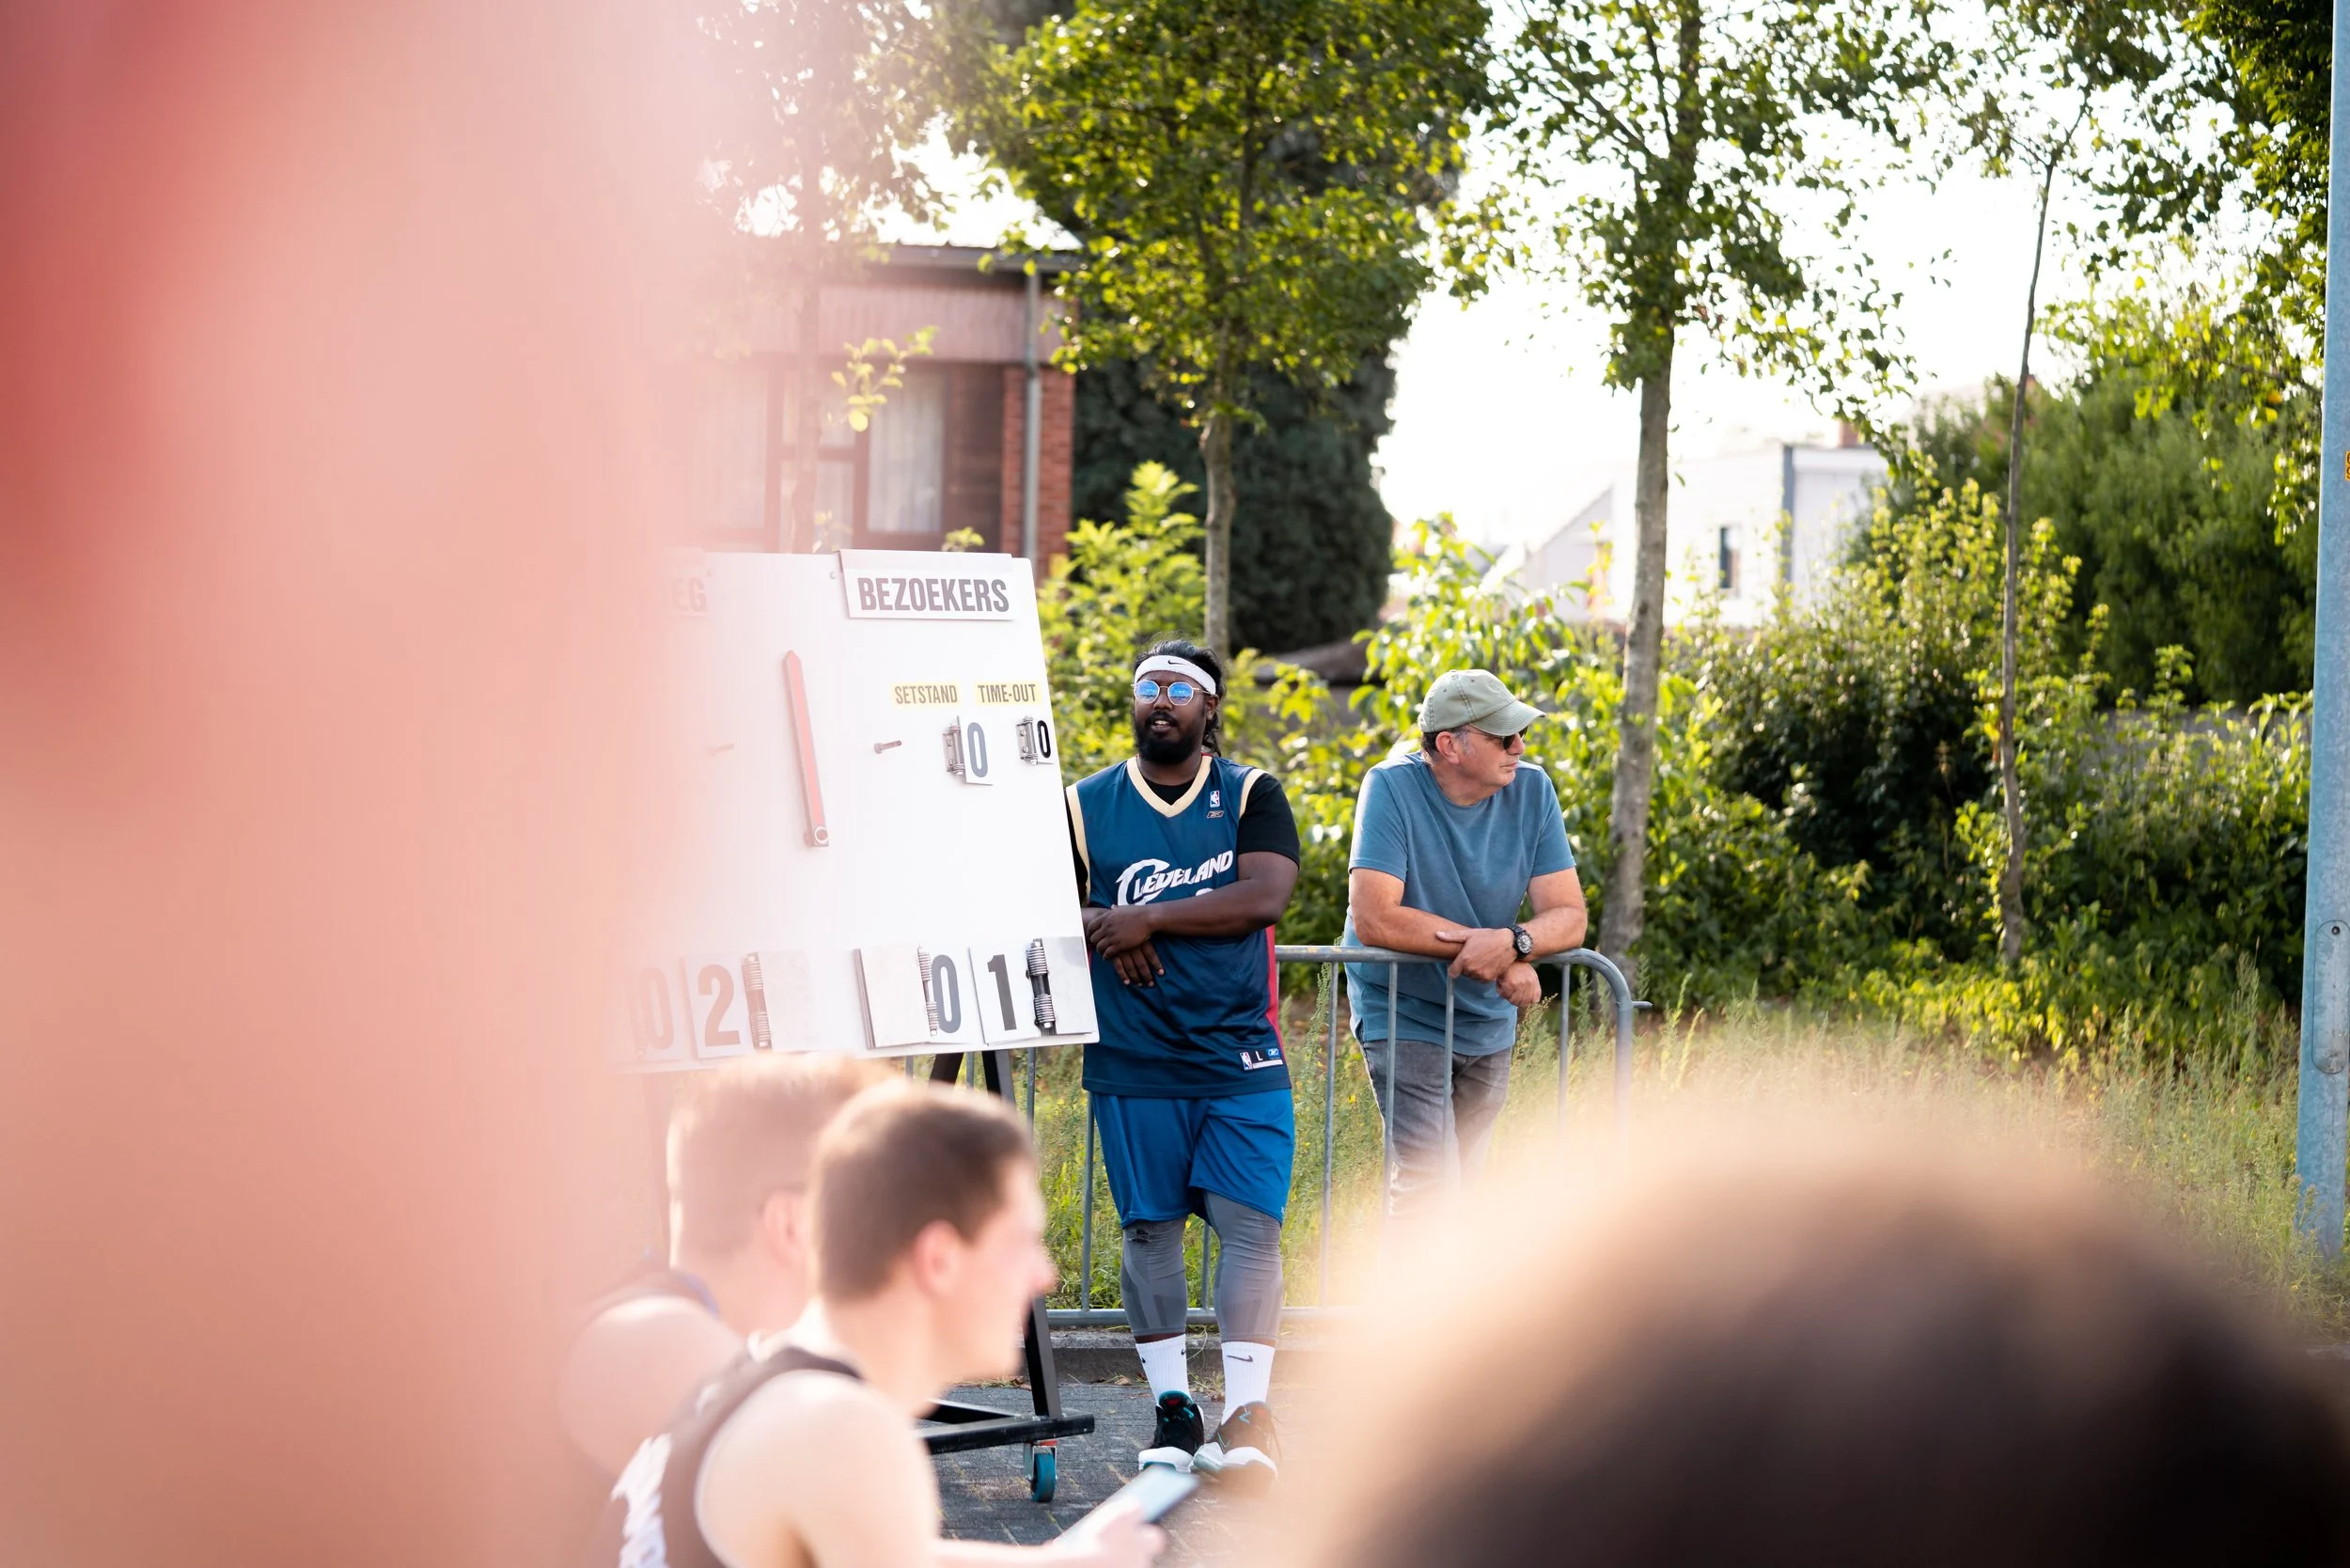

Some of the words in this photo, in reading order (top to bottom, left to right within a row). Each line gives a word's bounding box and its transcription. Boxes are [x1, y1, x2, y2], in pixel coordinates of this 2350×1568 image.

[671, 577, 707, 612] EG
[857, 578, 1010, 612] BEZOEKERS
[894, 685, 958, 704] SETSTAND
[978, 683, 1036, 703] TIME-OUT
[967, 722, 988, 777] 0
[1037, 720, 1051, 758] 0
[1115, 850, 1233, 905] CLEVELAND
[697, 964, 741, 1046] 2
[1255, 1050, 1263, 1061] L
